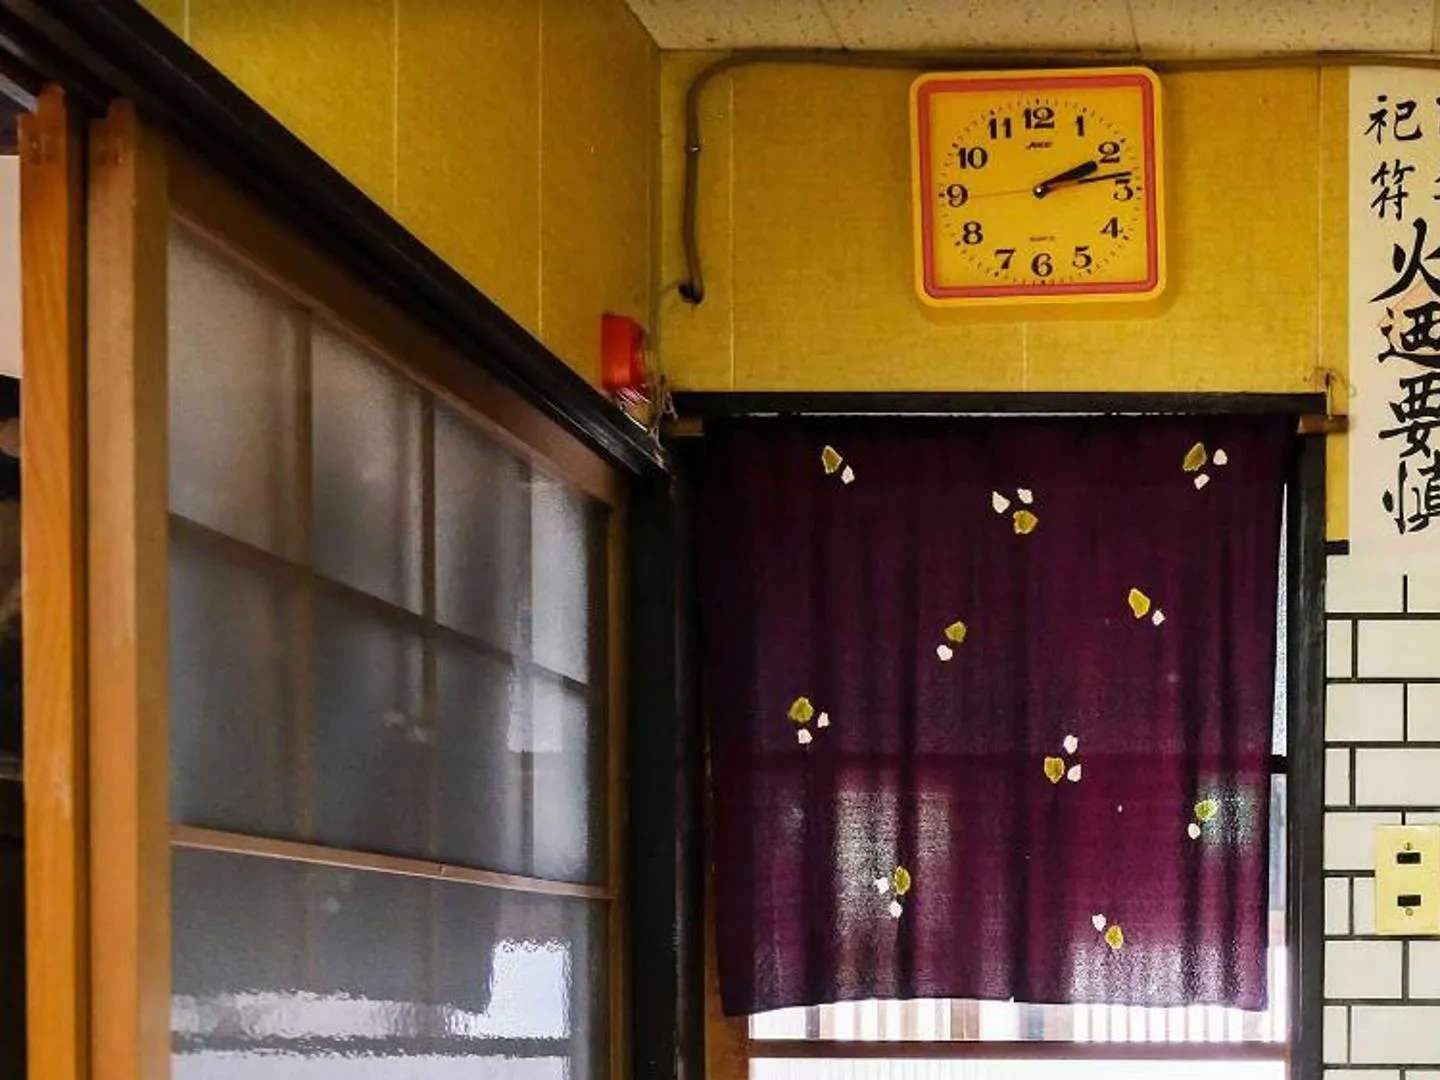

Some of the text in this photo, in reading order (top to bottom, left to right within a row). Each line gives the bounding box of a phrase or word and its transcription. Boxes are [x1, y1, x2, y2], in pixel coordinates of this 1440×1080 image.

[988, 117, 1012, 139] 11
[1024, 107, 1054, 129] 12
[1076, 115, 1085, 137] 1
[957, 147, 988, 169] 10
[1098, 142, 1121, 164] 2
[947, 184, 968, 207] 9
[1113, 178, 1134, 201] 3
[962, 222, 983, 244] 8
[1101, 217, 1123, 238] 4
[995, 249, 1016, 270] 7
[1031, 253, 1053, 277] 6
[1072, 247, 1092, 268] 5
